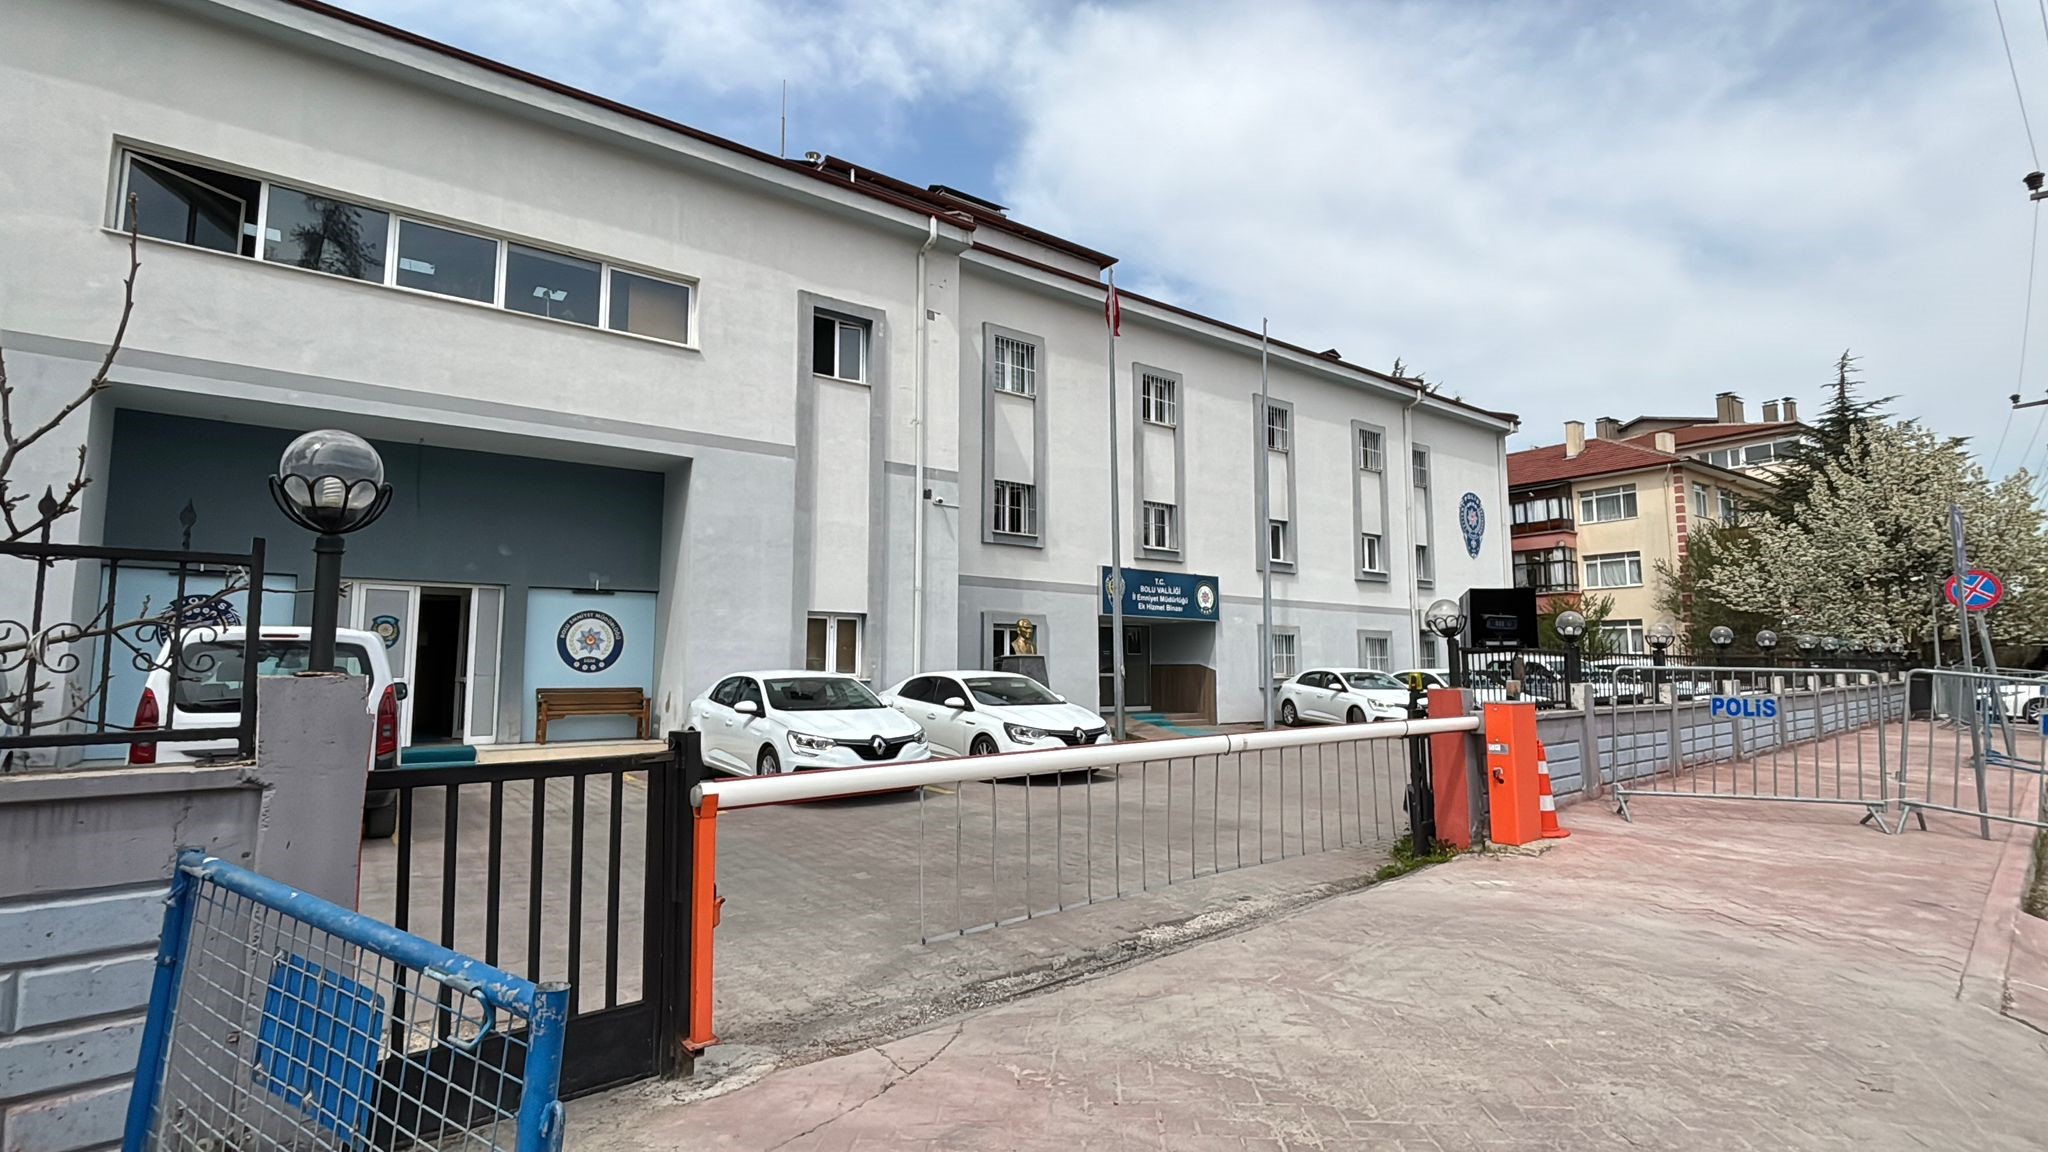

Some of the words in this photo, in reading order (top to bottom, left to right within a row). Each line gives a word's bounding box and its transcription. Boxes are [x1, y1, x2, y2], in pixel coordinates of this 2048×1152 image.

[1154, 578, 1166, 586] T.C.
[1156, 586, 1182, 594] VALİLİĞİ
[1137, 595, 1159, 604] Emniyet
[1160, 595, 1189, 605] Müdürlüğü
[1147, 603, 1166, 612] Hizmet
[1166, 604, 1184, 612] Binası
[560, 624, 571, 639] BOLU
[569, 612, 594, 625] EMNİYET
